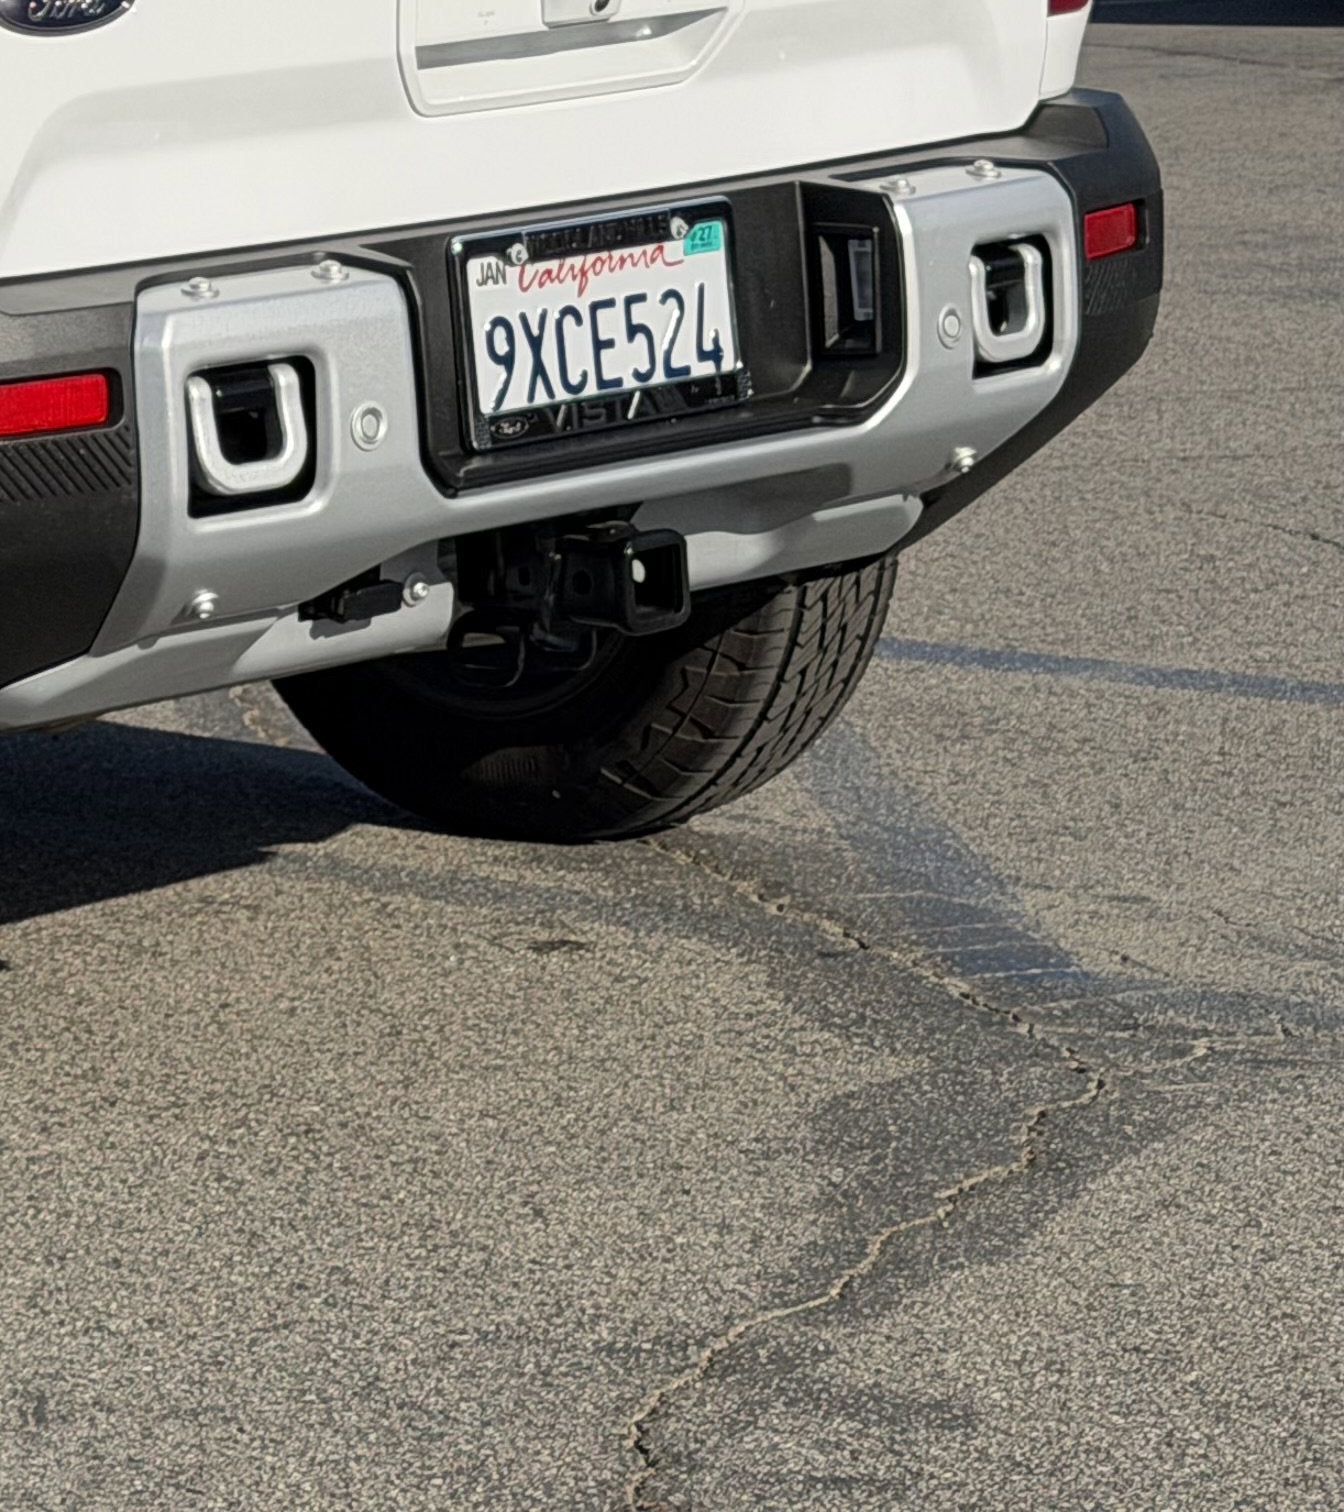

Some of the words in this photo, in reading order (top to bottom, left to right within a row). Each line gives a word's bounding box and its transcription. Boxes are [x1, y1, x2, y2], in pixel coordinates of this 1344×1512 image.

[476, 261, 507, 287] JAN
[517, 243, 685, 298] California
[484, 282, 724, 412] 9XCE524
